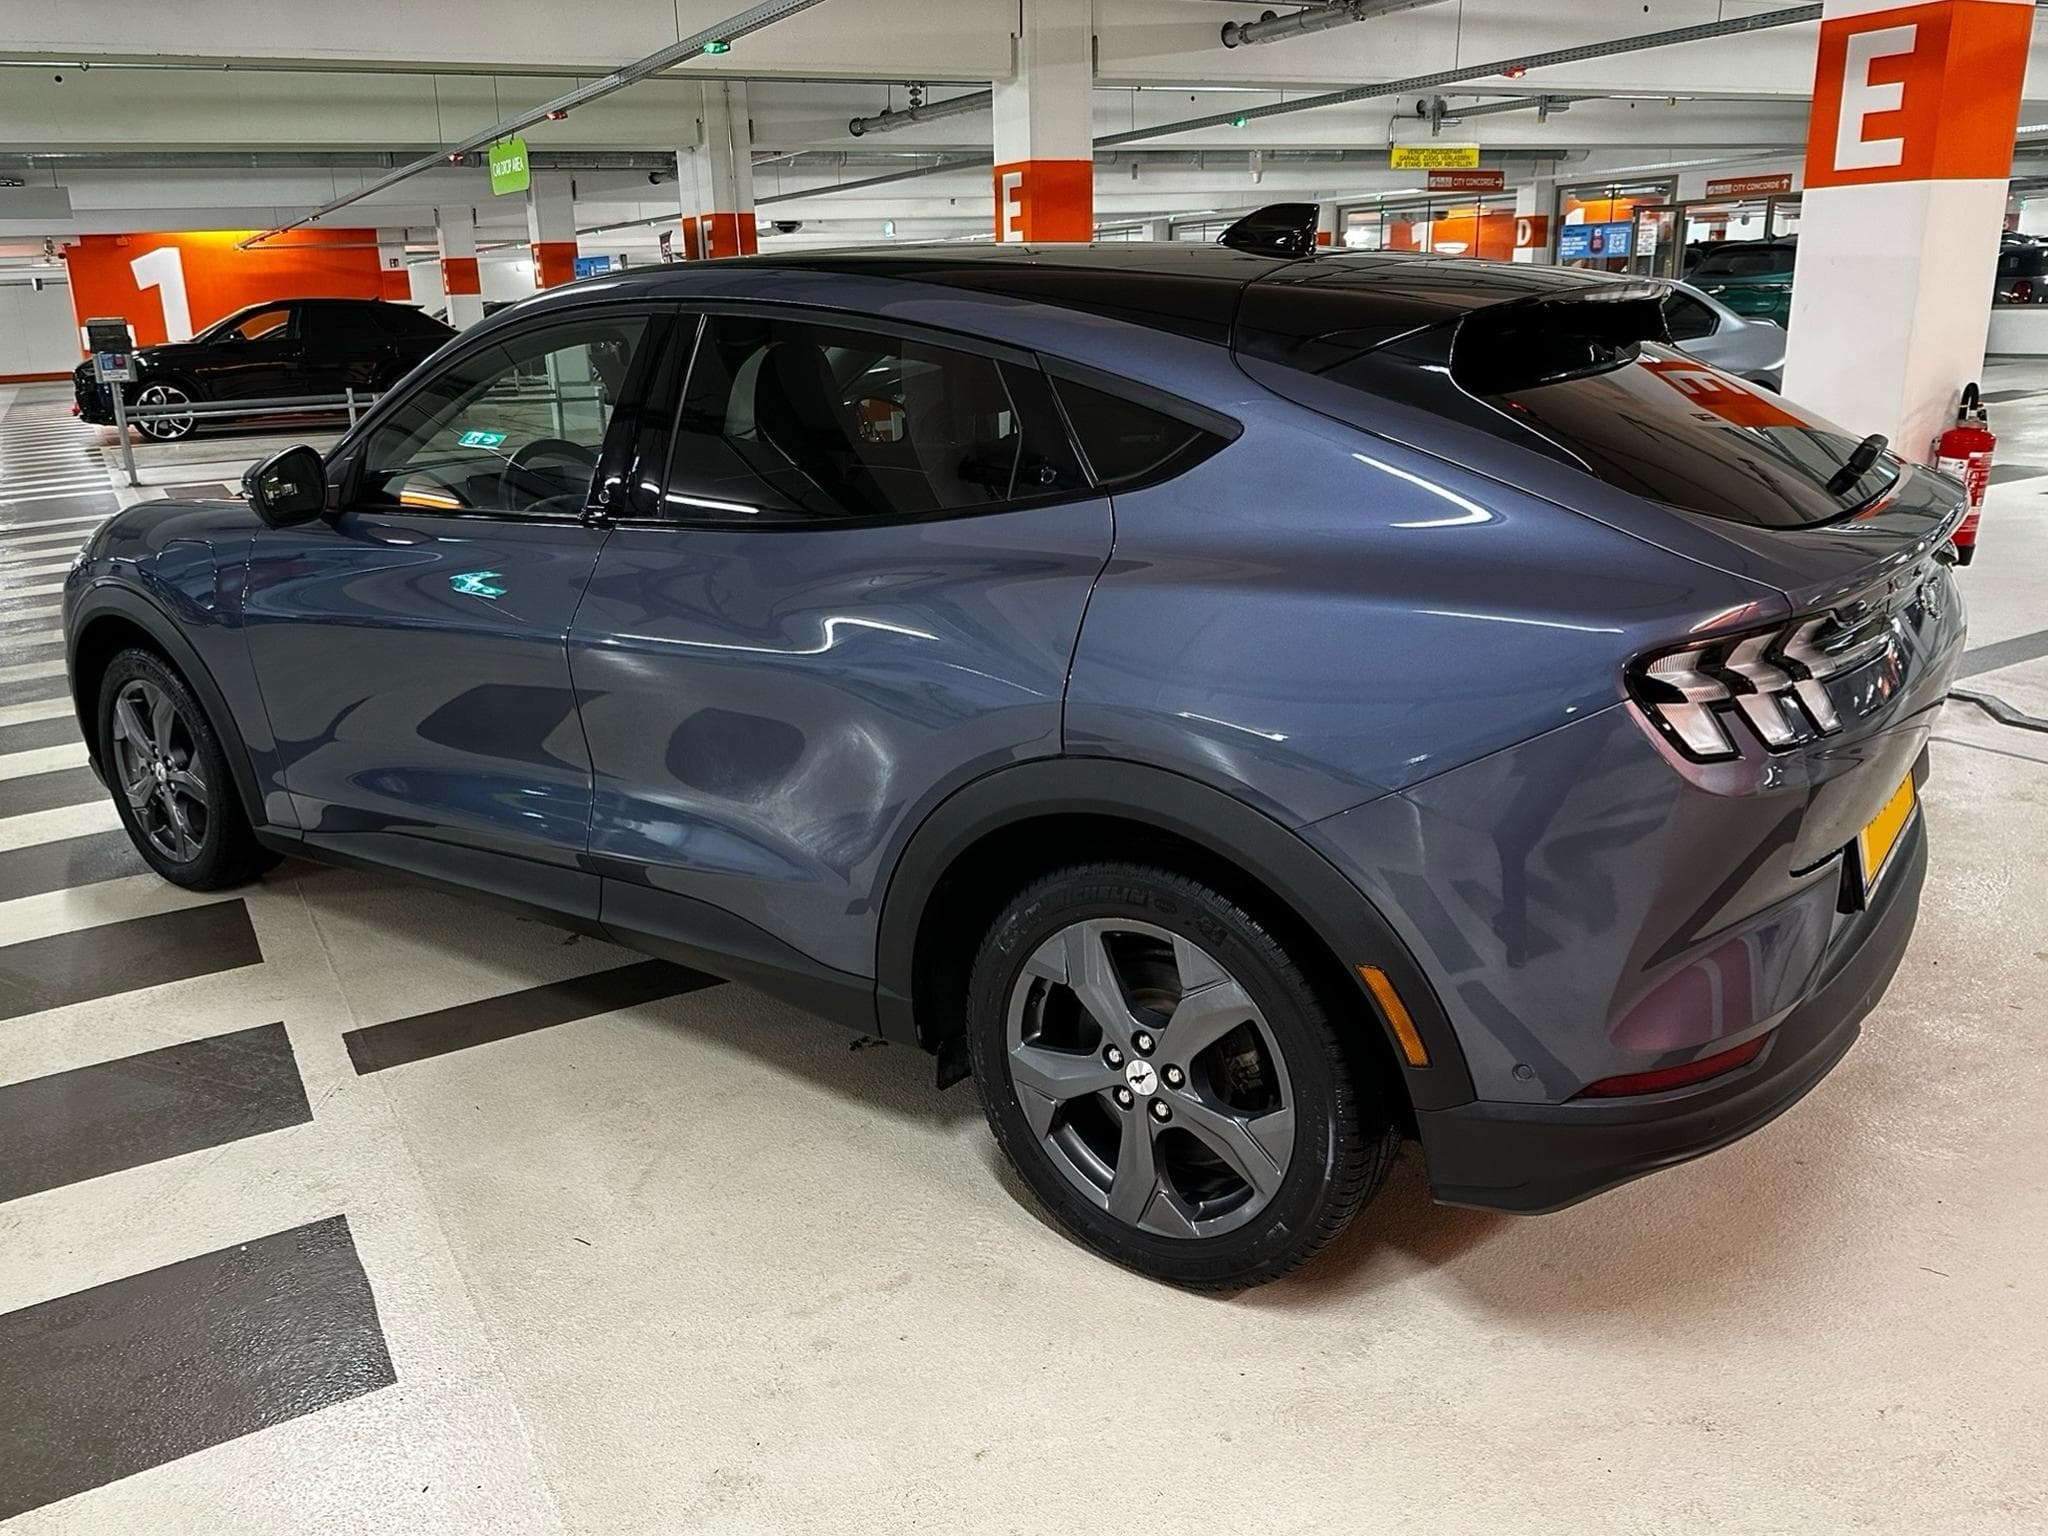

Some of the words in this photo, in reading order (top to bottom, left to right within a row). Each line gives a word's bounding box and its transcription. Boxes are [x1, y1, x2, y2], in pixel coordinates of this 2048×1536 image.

[1834, 24, 1918, 172] E
[1002, 171, 1023, 242] E
[1453, 177, 1465, 187] CITY
[1466, 177, 1495, 187] CONCORDE
[1733, 184, 1746, 192] CITY
[1747, 180, 1780, 191] CONCORDE
[1517, 218, 1532, 247] D
[129, 246, 195, 343] 1
